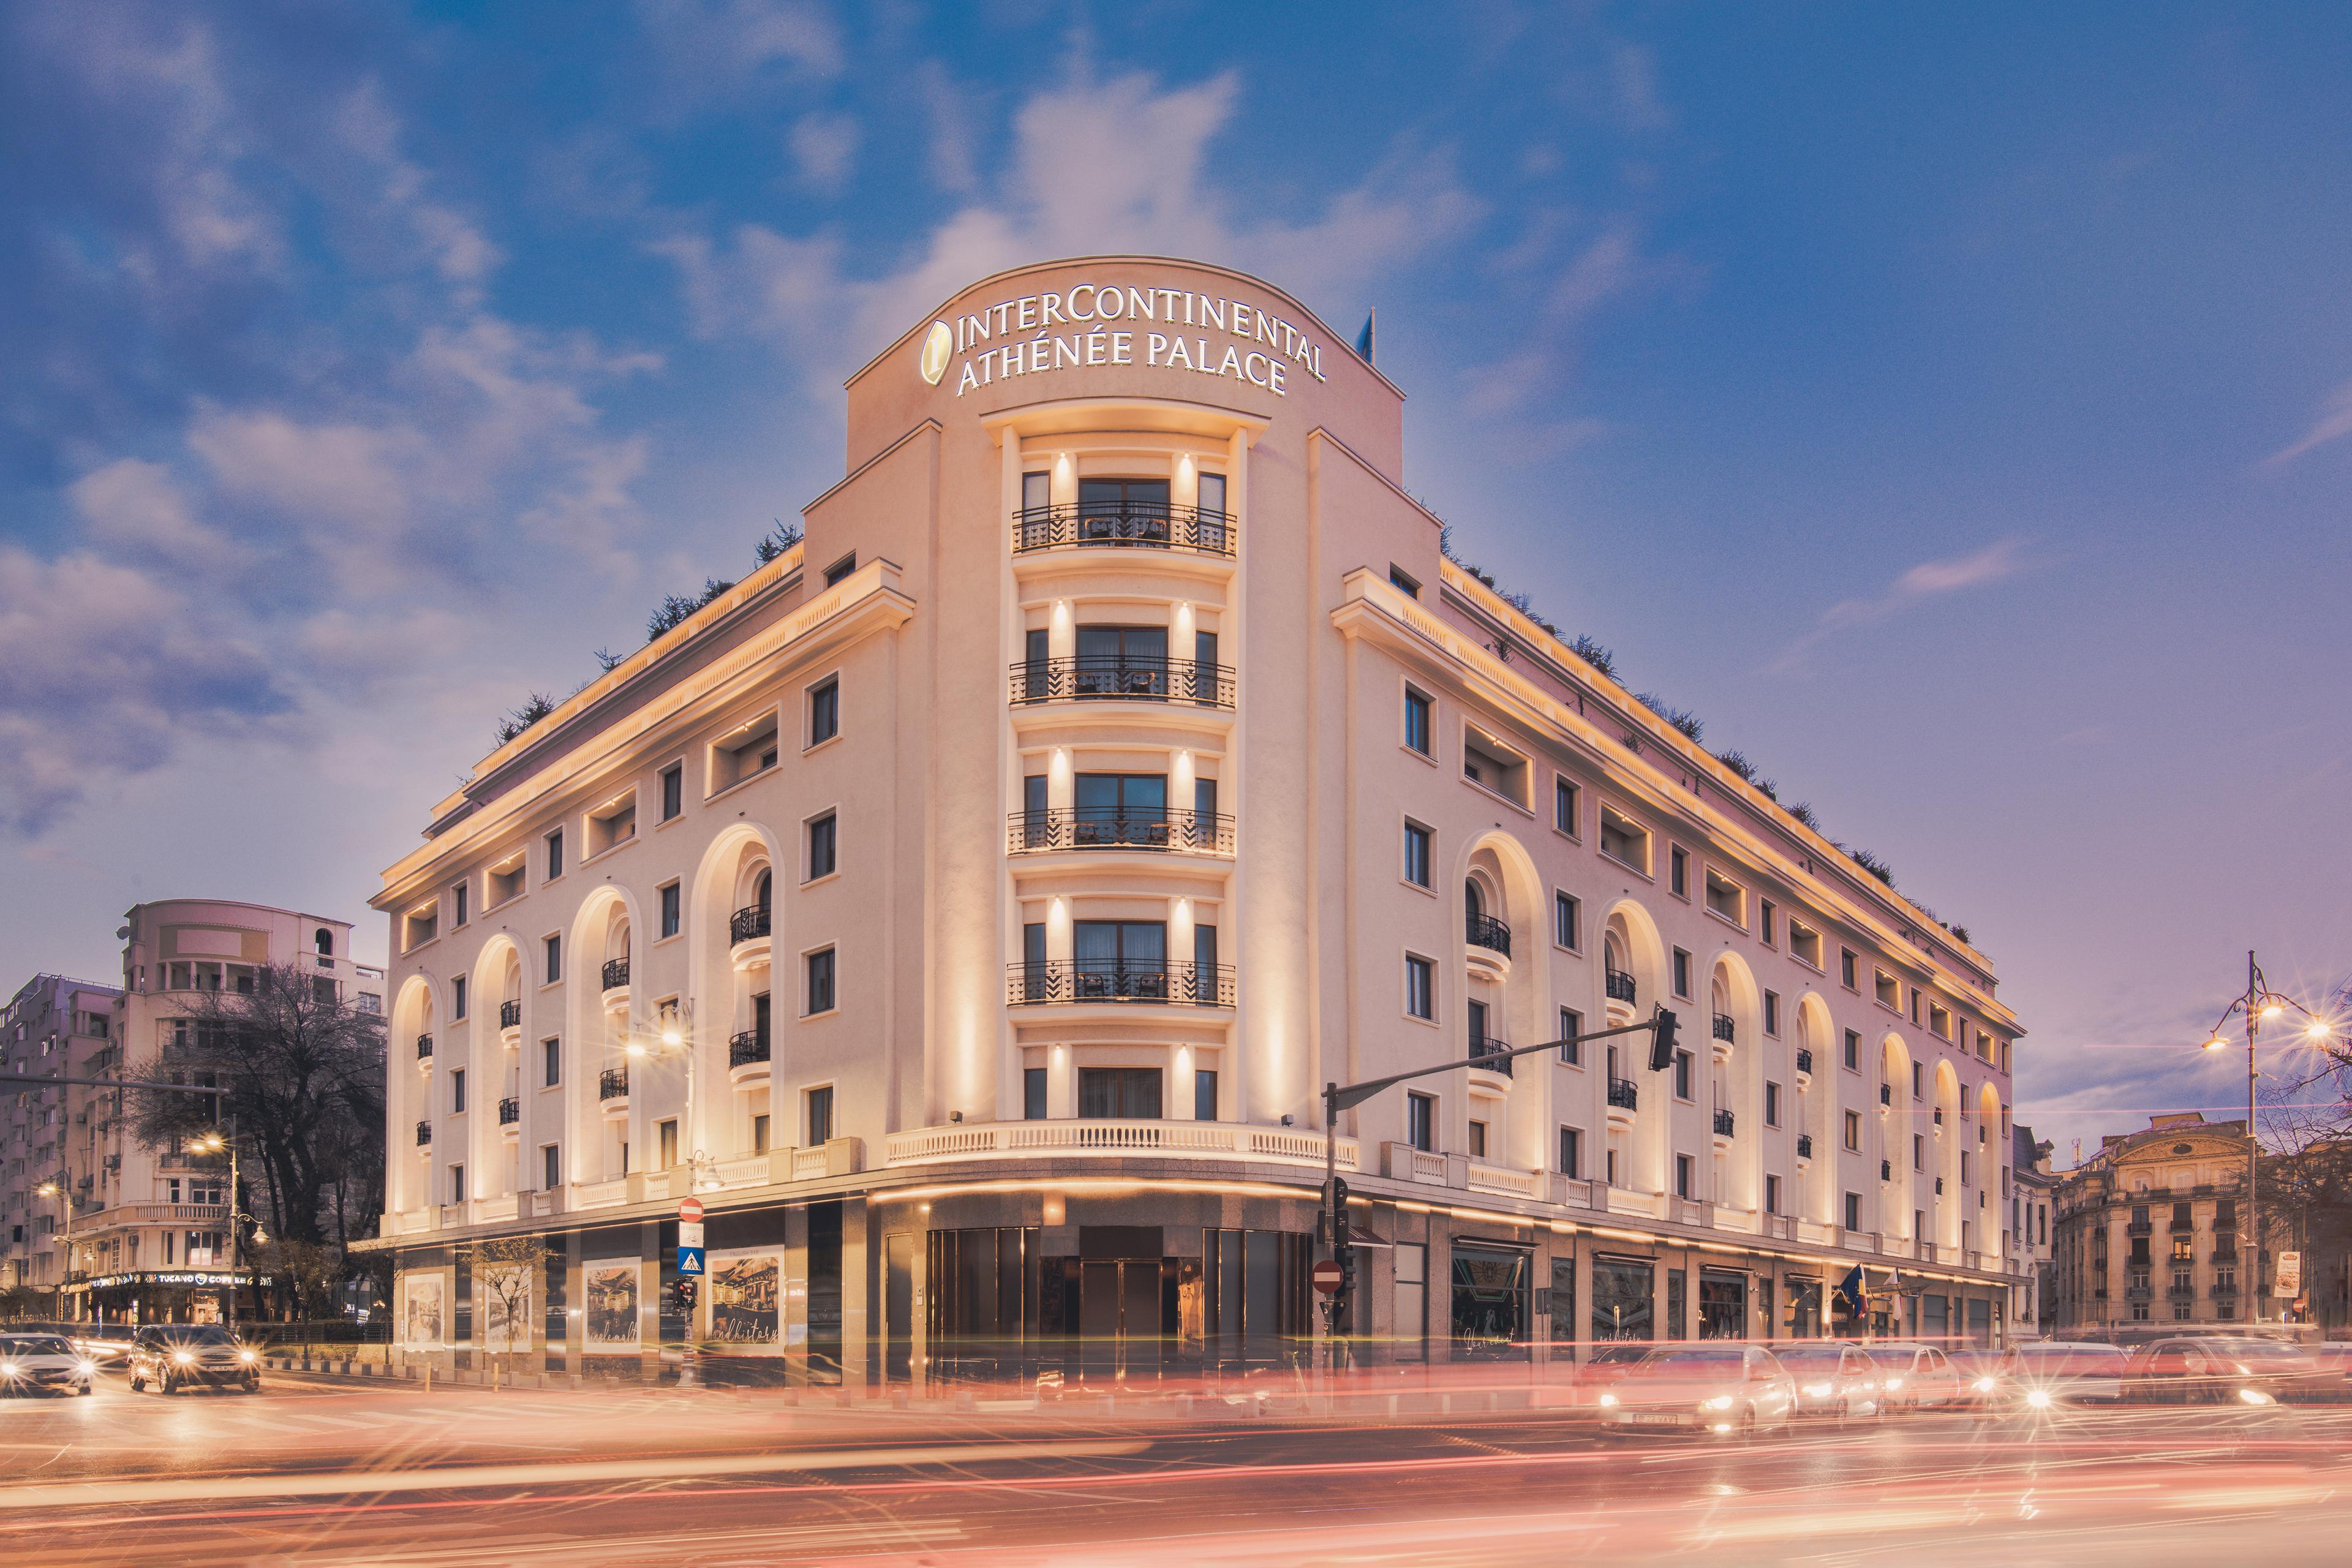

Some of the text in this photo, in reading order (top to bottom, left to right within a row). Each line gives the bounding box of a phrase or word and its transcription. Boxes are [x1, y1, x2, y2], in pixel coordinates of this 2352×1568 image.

[956, 284, 1325, 383] INTERCONTINENTAL
[956, 323, 1286, 398] ATHÉNÉE PALACE
